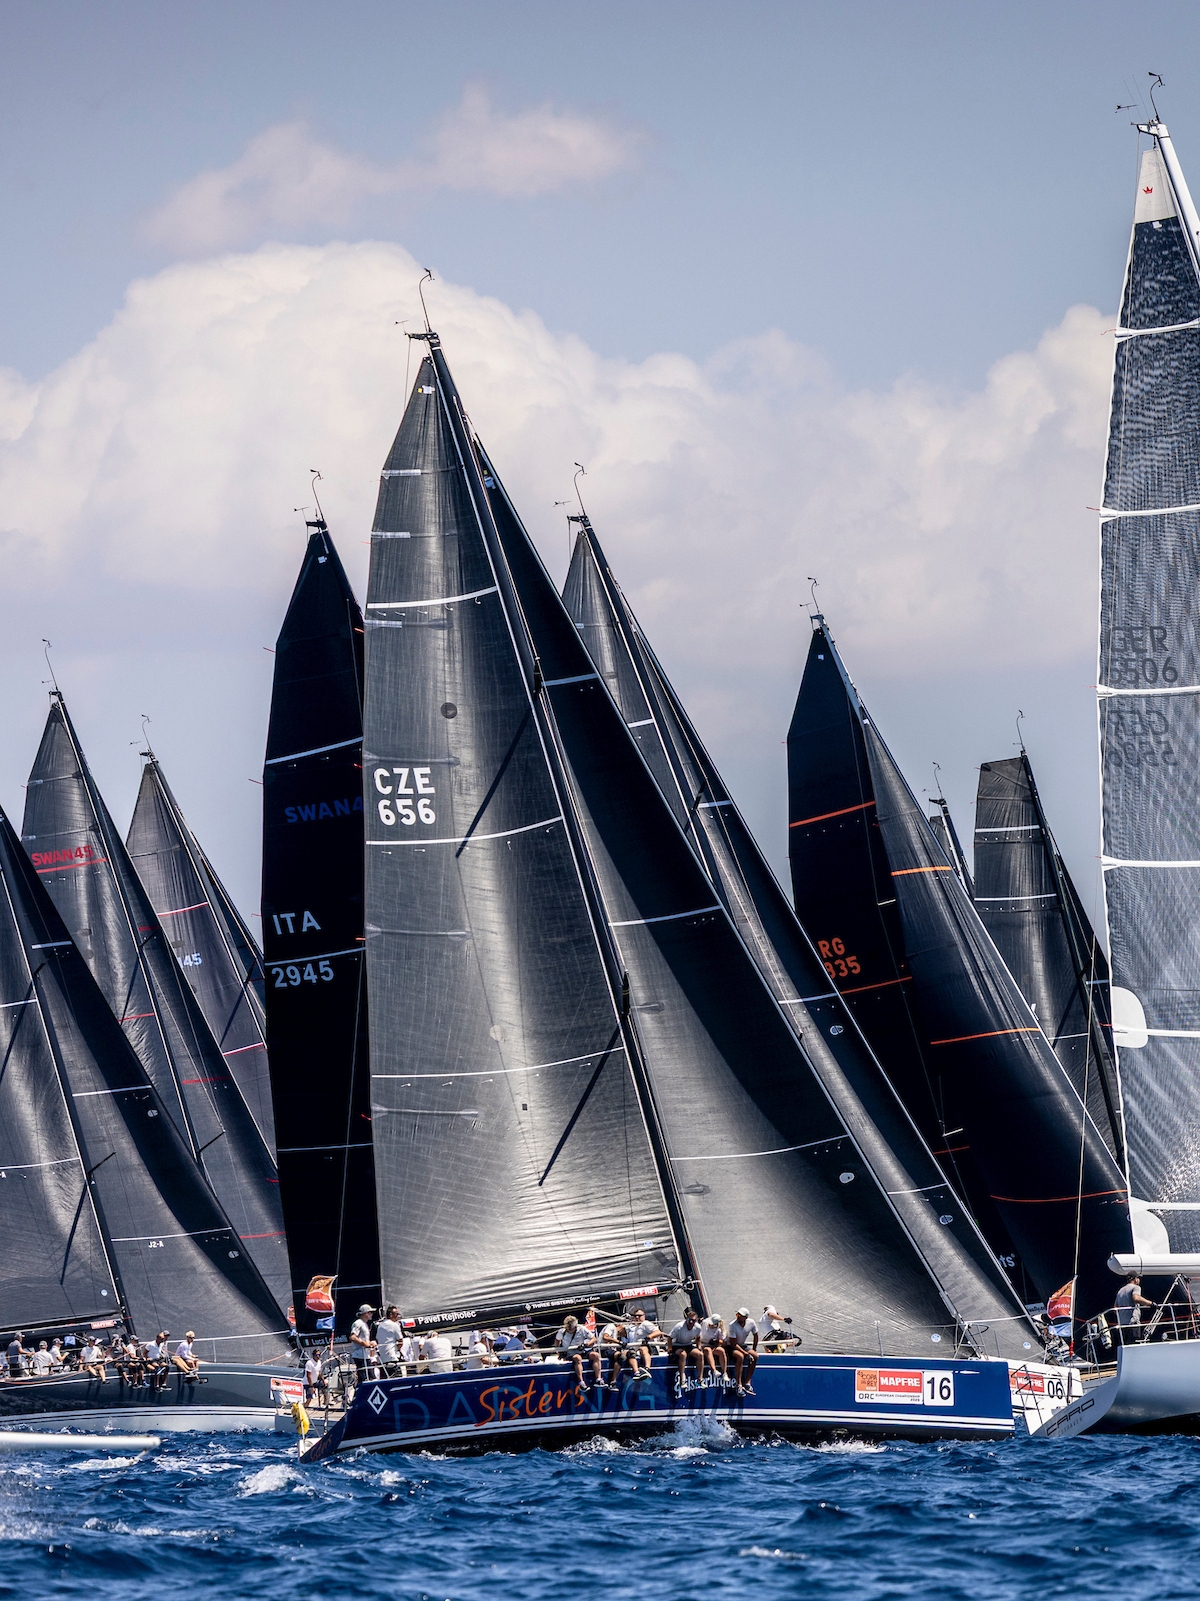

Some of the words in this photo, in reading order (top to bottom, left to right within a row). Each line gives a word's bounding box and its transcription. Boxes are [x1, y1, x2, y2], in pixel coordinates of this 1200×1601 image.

[1110, 626, 1169, 653] GER
[1109, 656, 1178, 684] 5506
[373, 767, 436, 795] CZE
[285, 796, 363, 823] SWAN4
[377, 798, 436, 826] 656
[272, 910, 321, 935] ITA
[271, 960, 335, 988] 2945
[622, 1288, 655, 1297] MAPFRE
[418, 1315, 440, 1324] Pavel
[441, 1311, 477, 1322] Rejholec
[880, 1377, 920, 1387] MAPFRE
[927, 1377, 951, 1400] 16
[1048, 1380, 1063, 1399] 06
[474, 1379, 585, 1427] Sisters
[1046, 1398, 1094, 1436] CARO
